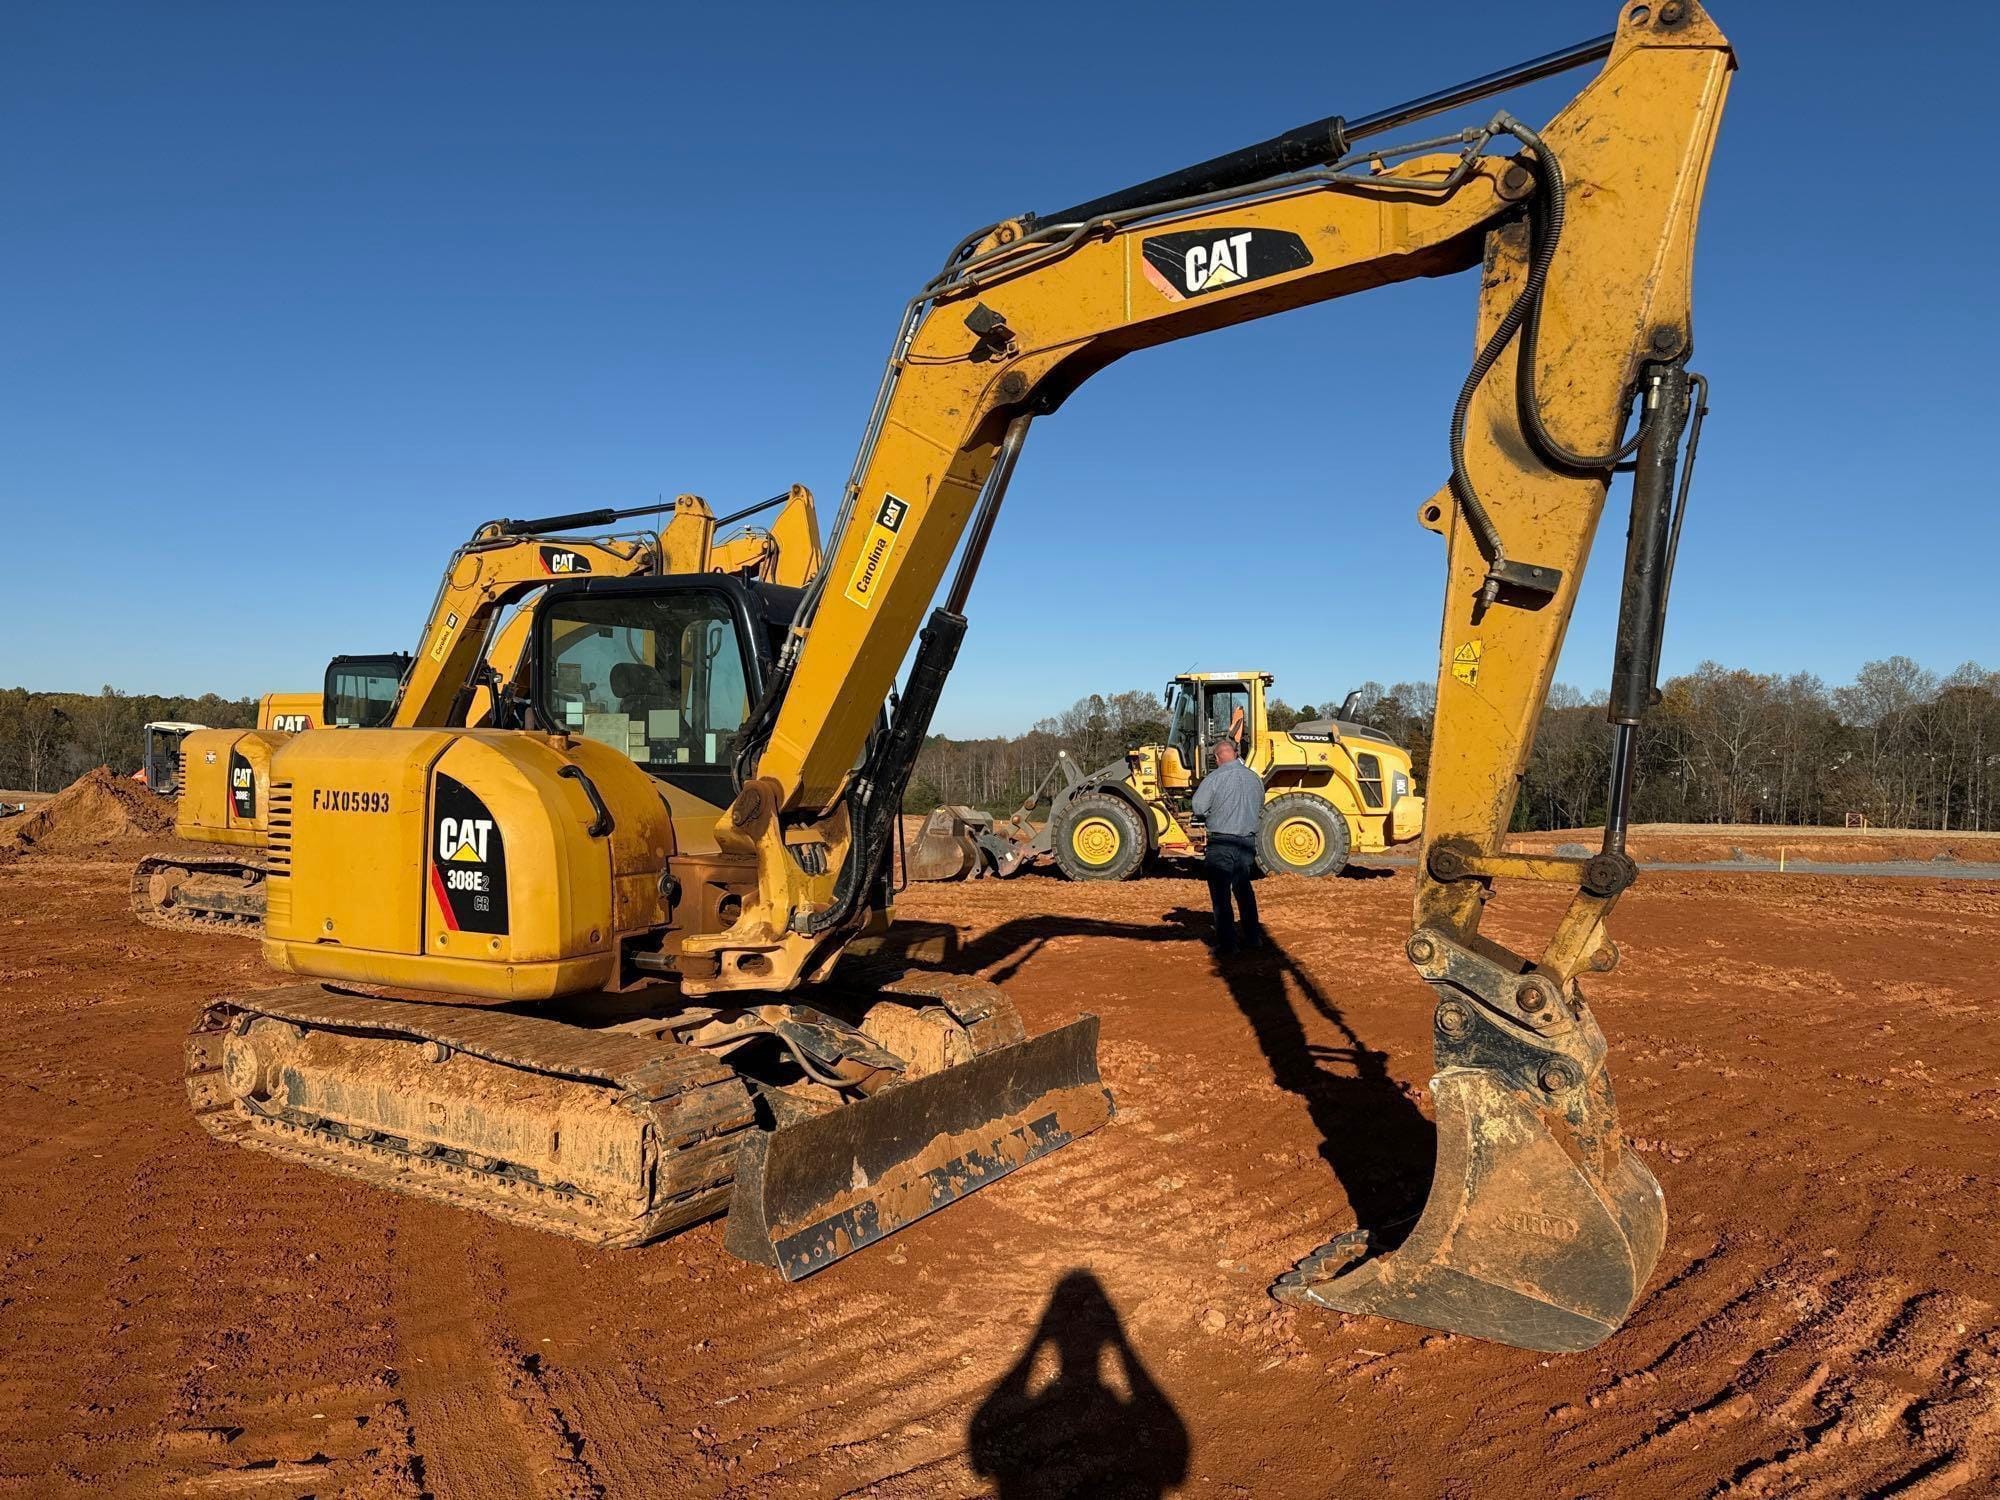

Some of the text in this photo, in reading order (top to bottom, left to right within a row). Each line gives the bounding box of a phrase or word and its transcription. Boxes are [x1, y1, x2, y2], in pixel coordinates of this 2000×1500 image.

[1185, 231, 1252, 292] CAT
[856, 500, 901, 593] Carolina CAT
[552, 553, 575, 573] CAT
[273, 715, 305, 732] CAT
[233, 768, 252, 788] CAT
[312, 789, 390, 813] FJX05993
[439, 817, 493, 863] CAT
[447, 869, 490, 892] 308E2
[474, 895, 489, 912] CR
